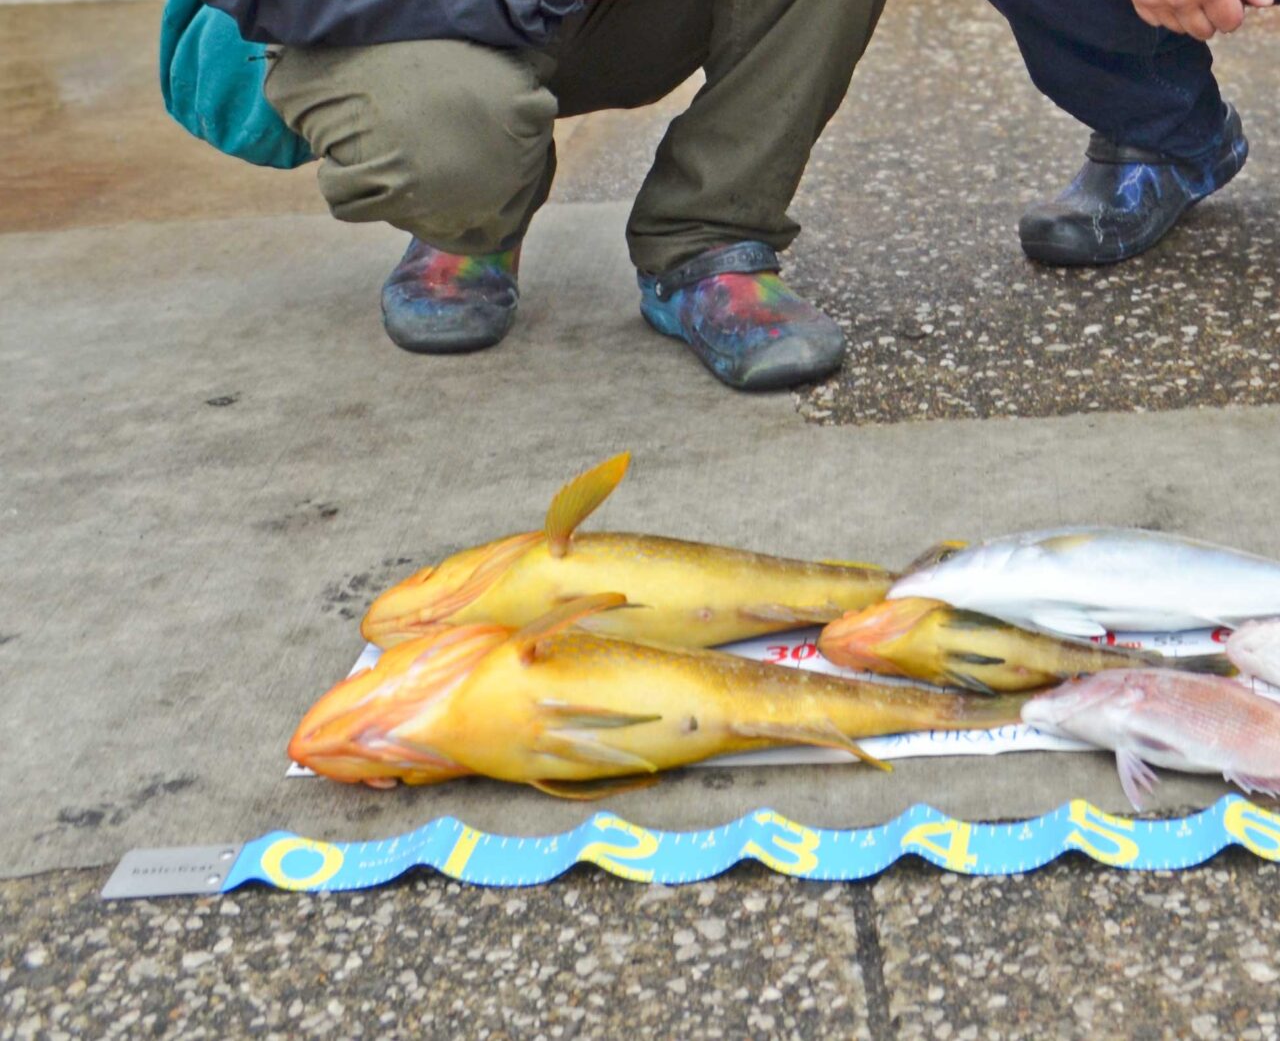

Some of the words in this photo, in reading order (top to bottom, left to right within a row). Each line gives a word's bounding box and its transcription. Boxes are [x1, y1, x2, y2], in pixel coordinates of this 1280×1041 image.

[261, 837, 344, 890] 0
[443, 824, 482, 879] 1
[576, 817, 658, 883] 2
[739, 811, 821, 874] 3
[900, 818, 978, 873] 4
[1064, 799, 1139, 866] 5
